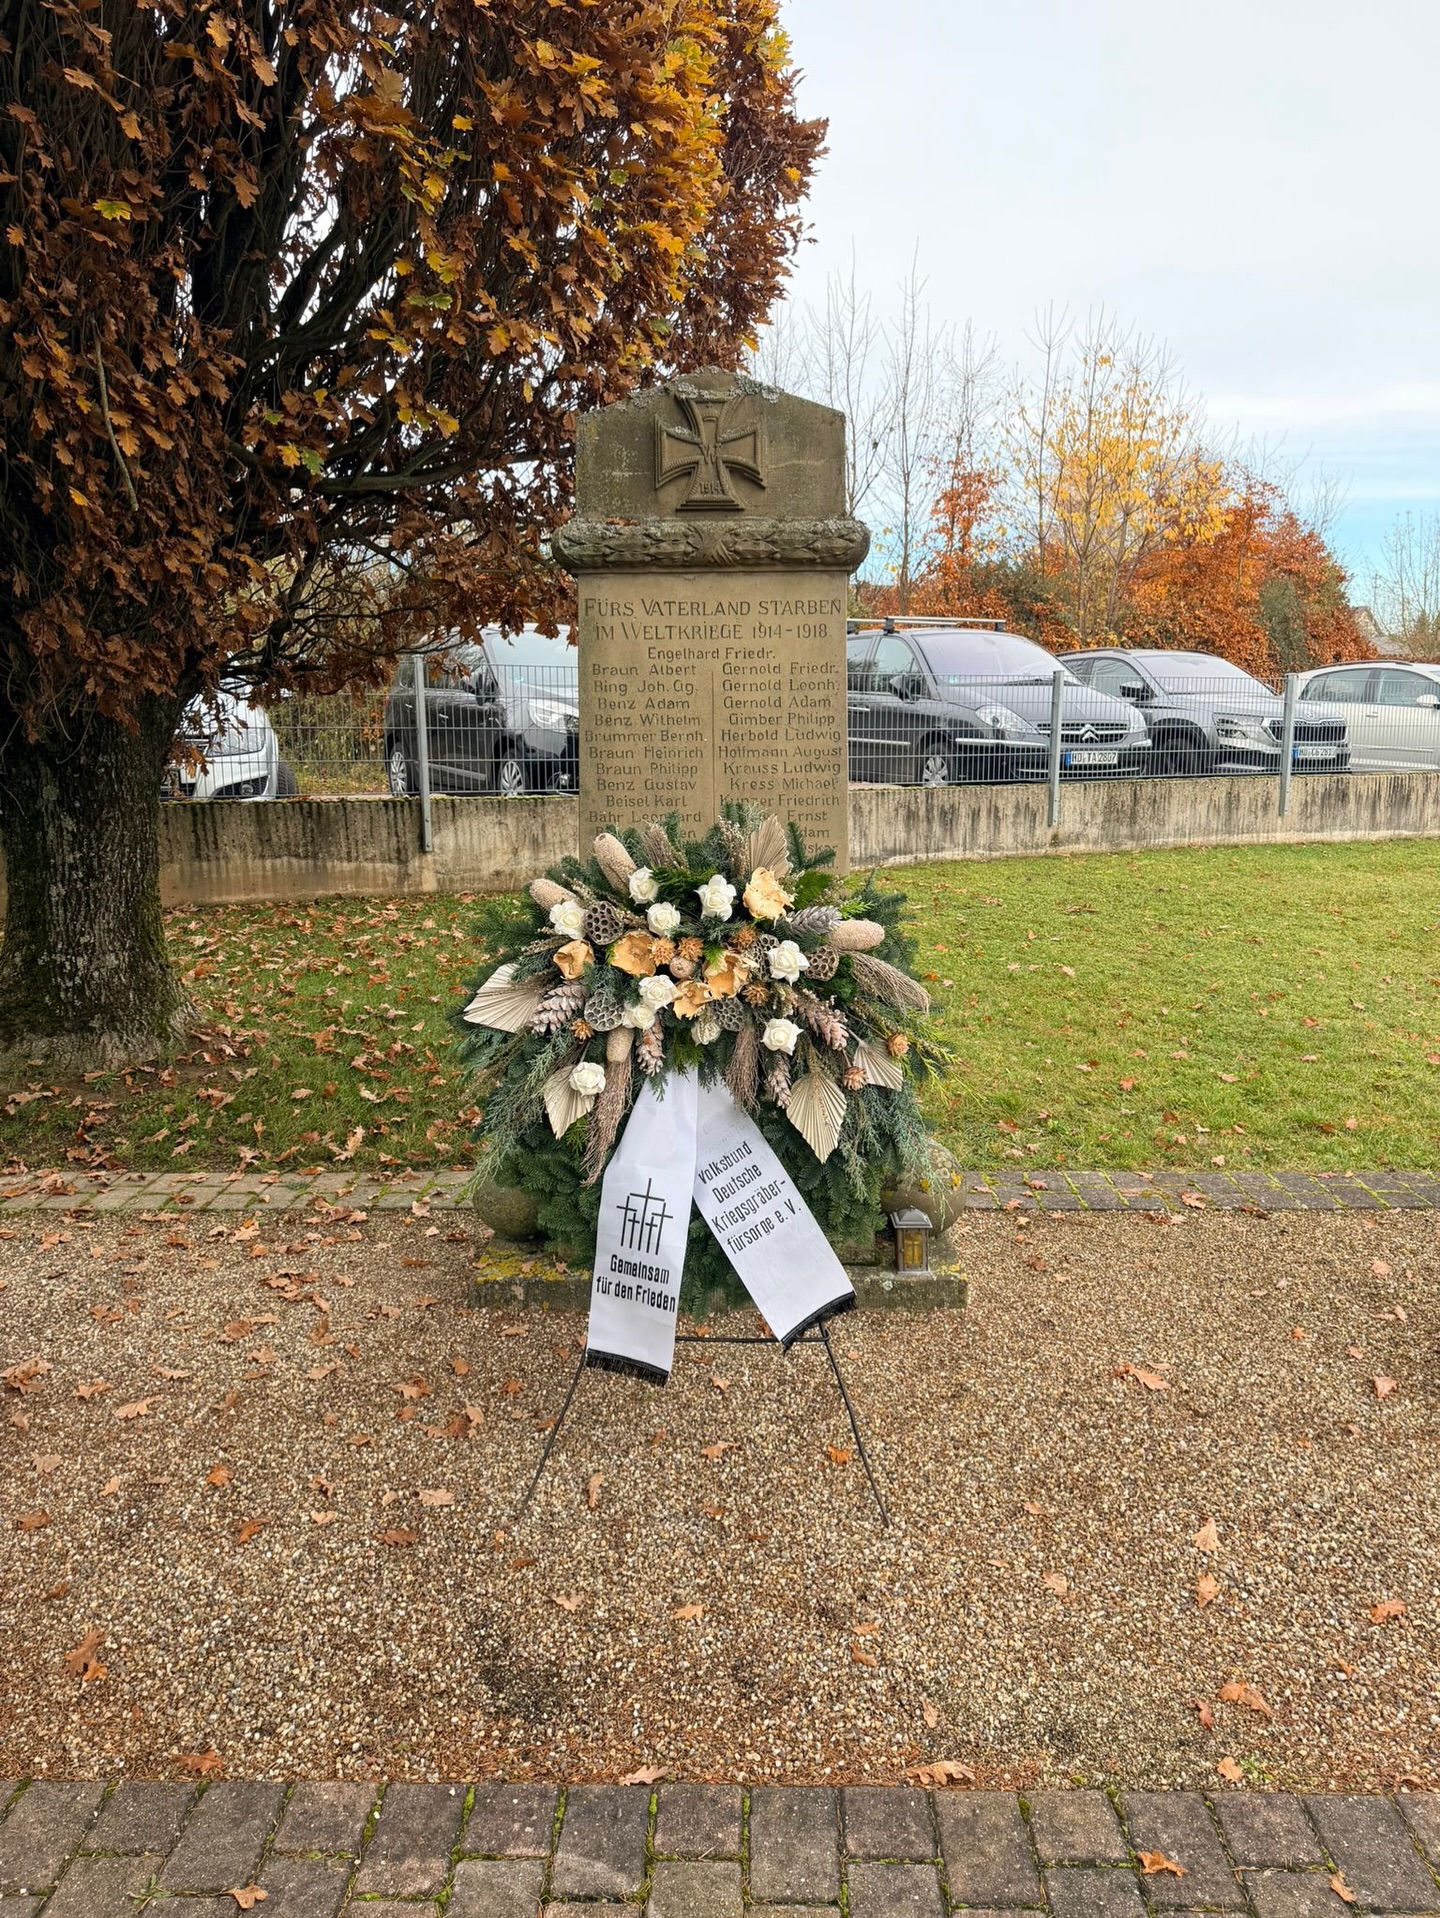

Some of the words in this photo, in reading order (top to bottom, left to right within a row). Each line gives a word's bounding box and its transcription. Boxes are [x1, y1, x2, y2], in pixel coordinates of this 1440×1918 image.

[584, 598, 635, 617] FÜRS
[641, 598, 751, 617] VATERLAND
[758, 599, 842, 616] STARBEN
[620, 621, 744, 640] WELTKRIEGE
[648, 646, 720, 663] Engelhard
[725, 647, 776, 660] Friedr.
[592, 663, 639, 676] Braun
[649, 663, 697, 676] Albert
[722, 662, 781, 675] Gernold
[790, 662, 840, 675] Friedr.
[594, 680, 628, 697] Bing
[722, 679, 782, 692] Gernold
[598, 697, 637, 710] Benz
[645, 697, 690, 710] Adam
[723, 695, 782, 709] Gernold
[788, 695, 832, 709] Adam
[595, 714, 633, 727] Benz
[639, 713, 701, 726] Wilhelm
[729, 712, 783, 726] Gimber
[787, 712, 835, 727] Philipp
[584, 730, 657, 742] Brummer
[721, 729, 778, 742] Herbold
[785, 728, 841, 743] Ludwig
[589, 746, 635, 759] Braun
[644, 746, 704, 759] Heinrich
[718, 746, 788, 759] Hoffmann
[793, 746, 842, 760] August
[596, 762, 641, 775] Braun
[650, 762, 698, 777] Philipp
[723, 761, 779, 776] Krauss
[783, 760, 841, 776] Ludwig
[597, 778, 636, 791] Benz
[644, 778, 697, 791] Gustav
[730, 777, 775, 791] Kress
[782, 778, 838, 790] Michael
[606, 794, 651, 808] Beisel
[654, 794, 688, 808] Karl
[778, 793, 840, 807] Friedrich
[589, 810, 624, 823] Bähr
[631, 810, 702, 823] Leonard
[787, 809, 828, 821] Ernst
[698, 1140, 753, 1185] Volksbund
[711, 1164, 762, 1204] Deutsche
[711, 1179, 786, 1235] Kriegsgräber-
[727, 1216, 775, 1255] fürsorge
[610, 1254, 670, 1285] Gemeinsam
[596, 1275, 613, 1295] für
[614, 1280, 633, 1301] den
[635, 1284, 676, 1313] Frieden
